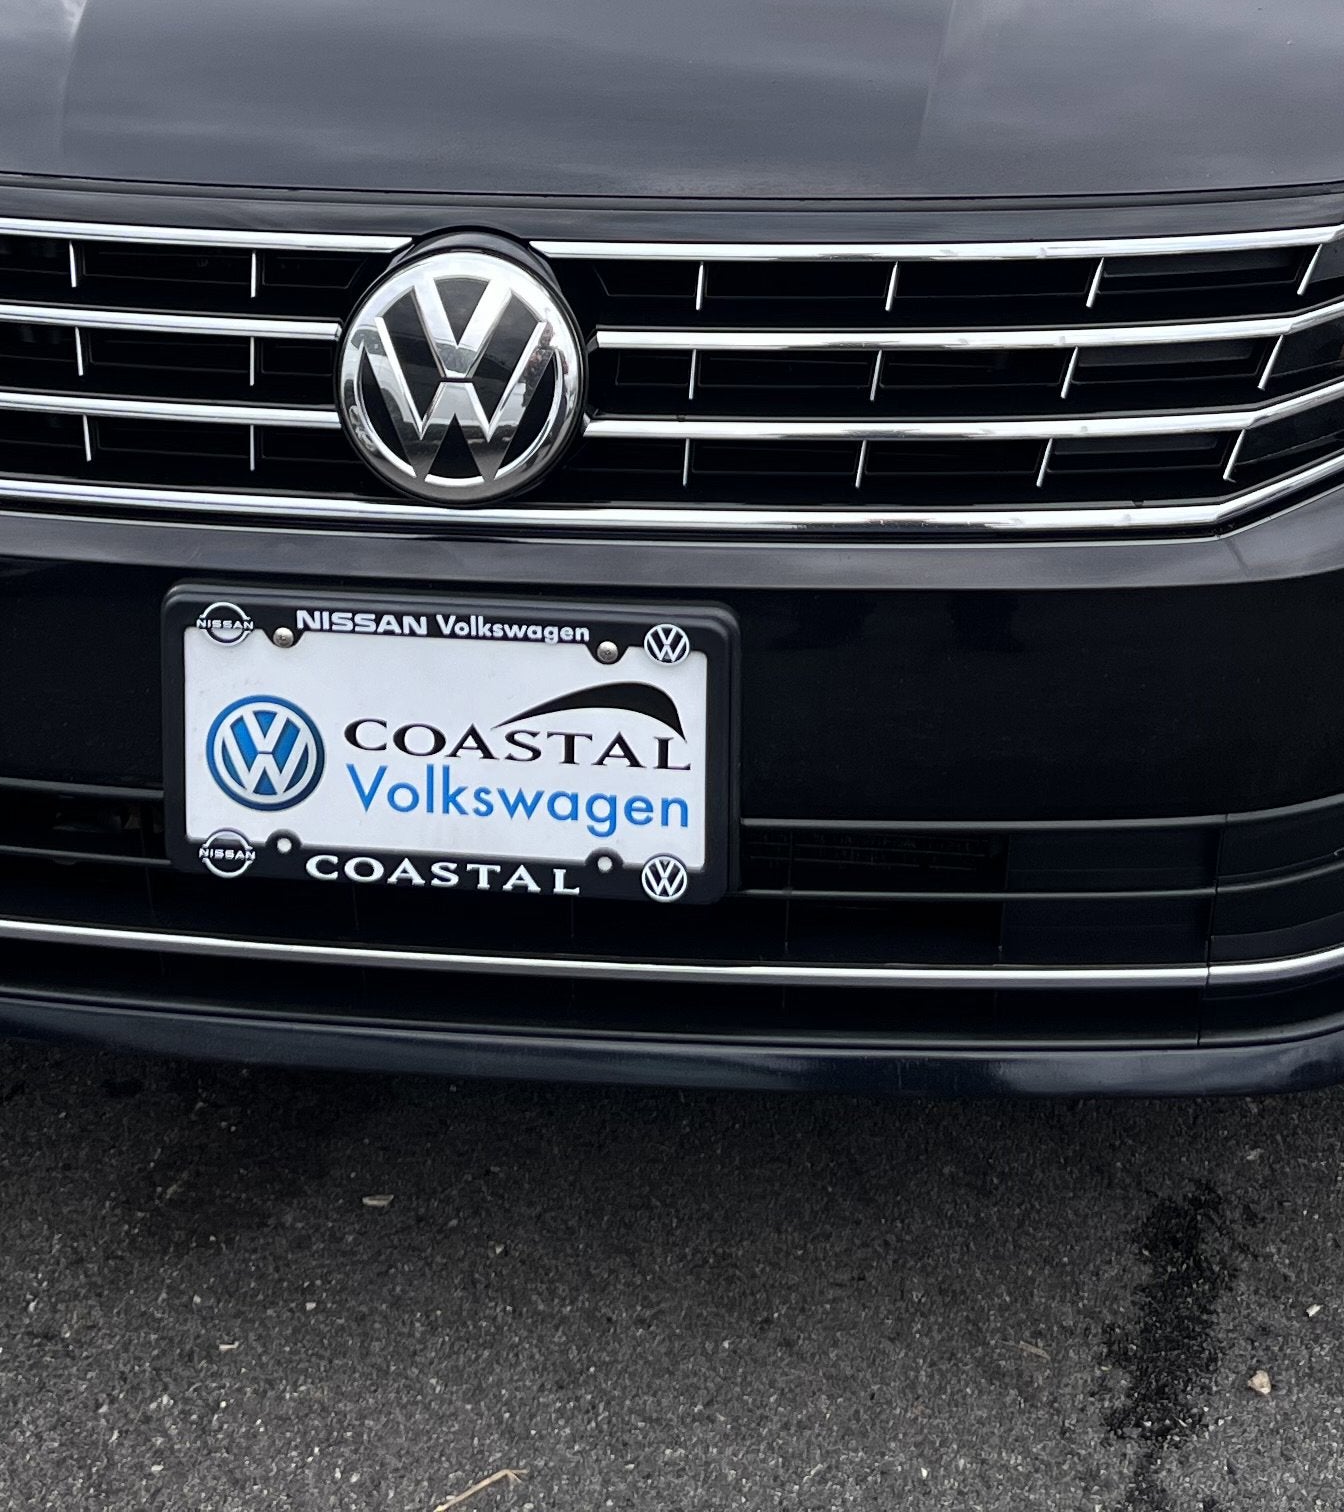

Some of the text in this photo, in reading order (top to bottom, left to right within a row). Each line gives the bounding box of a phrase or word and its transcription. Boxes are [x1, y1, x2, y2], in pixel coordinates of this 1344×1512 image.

[196, 619, 254, 630] NISSAN
[296, 609, 590, 644] NISSAN Volkswagen
[344, 718, 692, 771] COASTAL
[346, 763, 689, 838] Volkswagen
[199, 848, 256, 860] NISSAN
[305, 854, 581, 896] COASTAL
